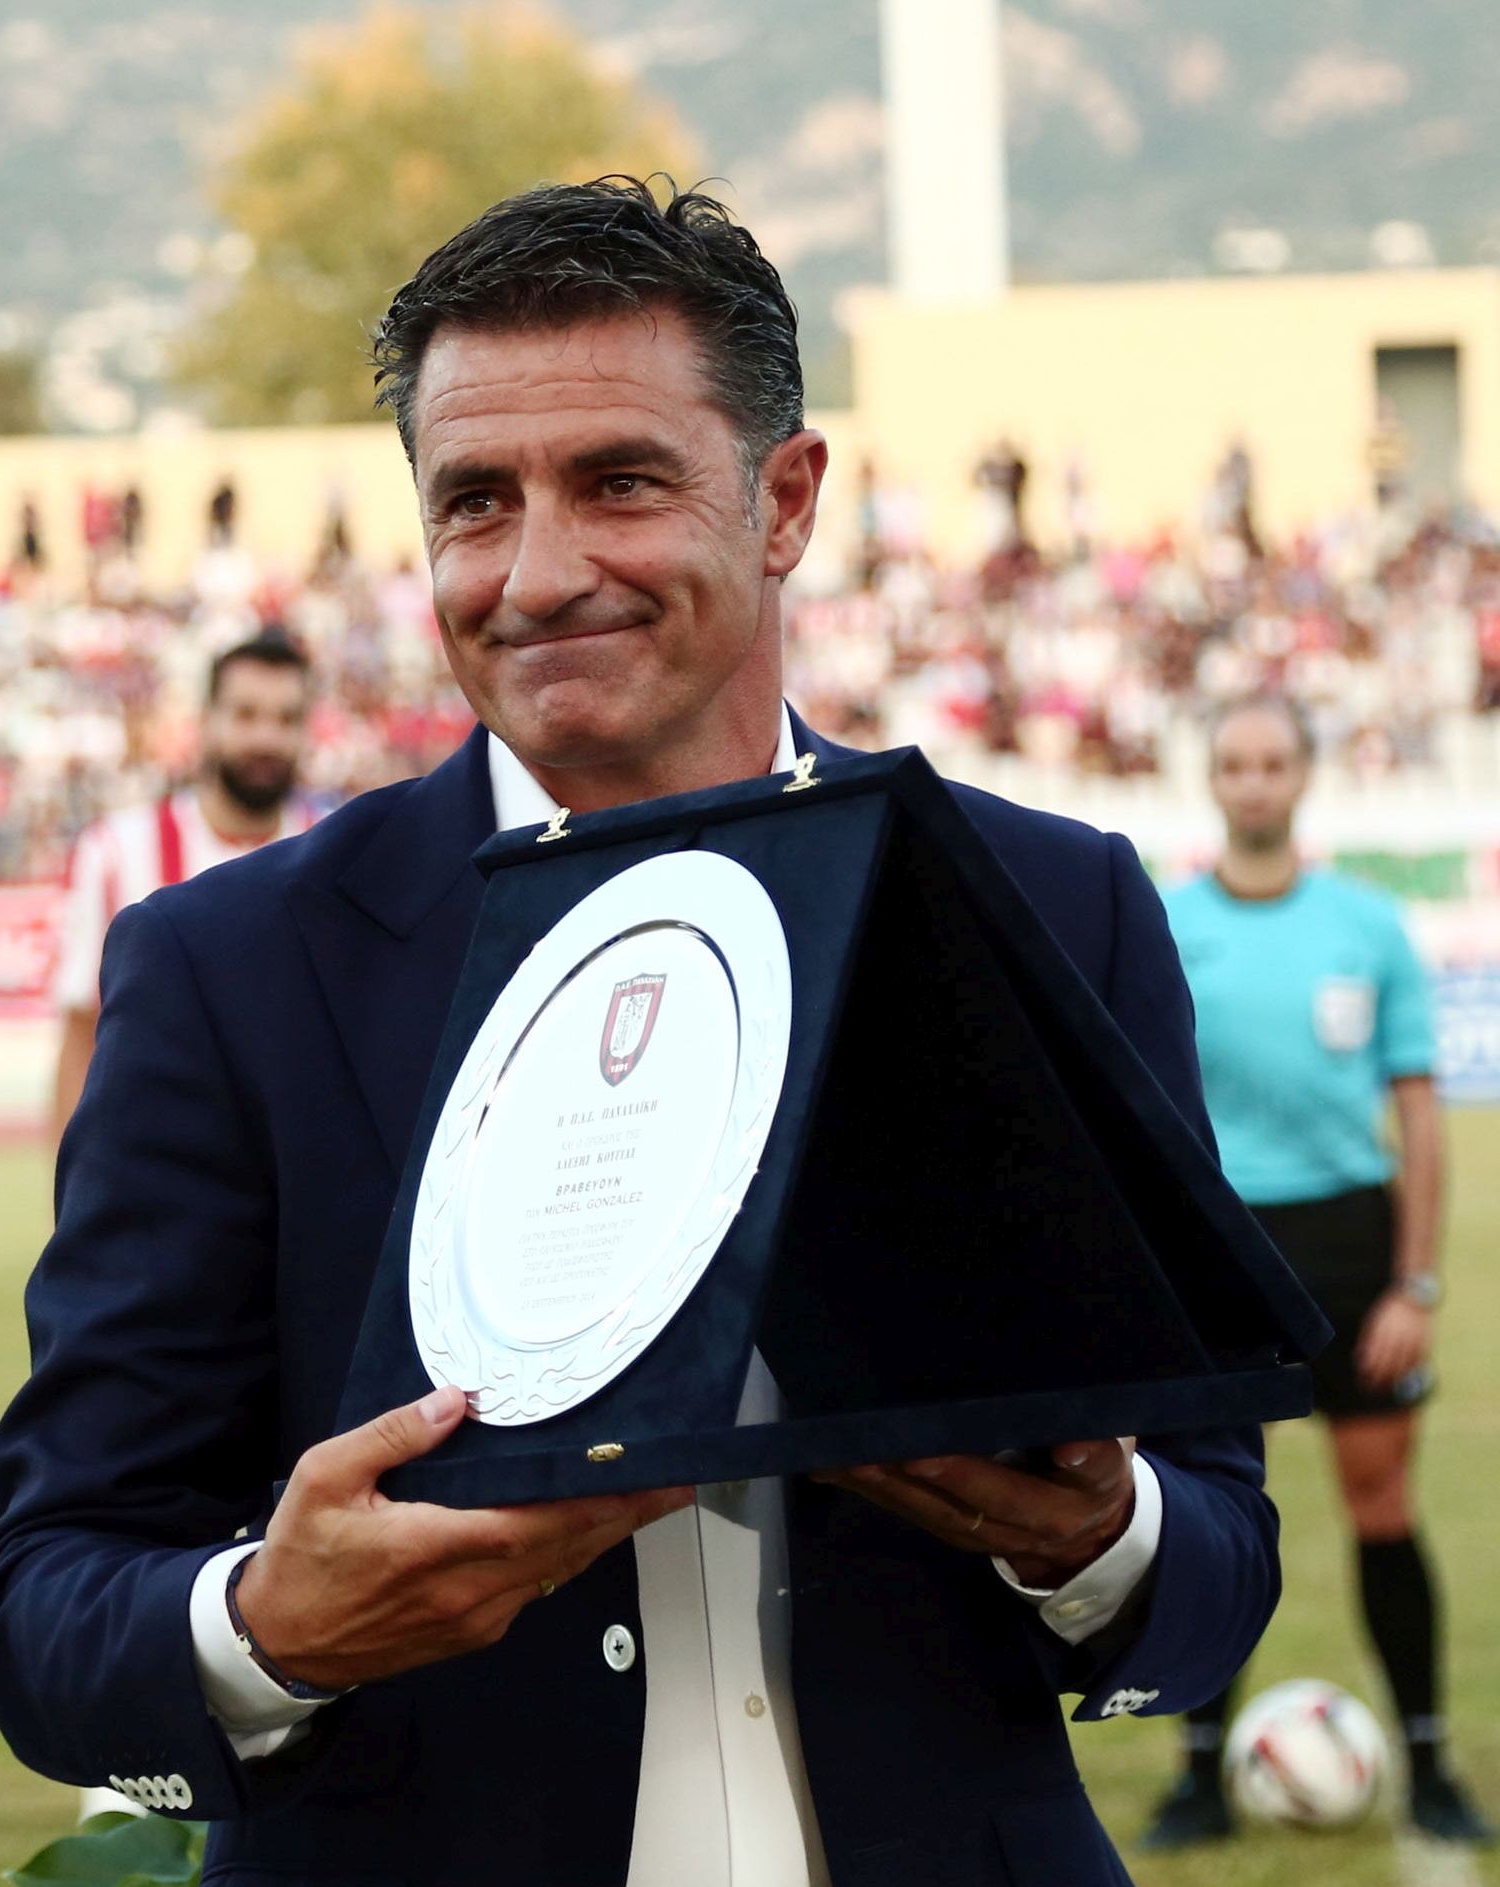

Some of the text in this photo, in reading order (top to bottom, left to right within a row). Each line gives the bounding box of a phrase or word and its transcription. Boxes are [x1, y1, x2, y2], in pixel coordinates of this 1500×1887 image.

[556, 1176, 622, 1197] ΒΡΑΒΕΥΟΥΝ
[544, 1201, 581, 1215] MICHEL
[586, 1191, 643, 1210] GONZALEZ
